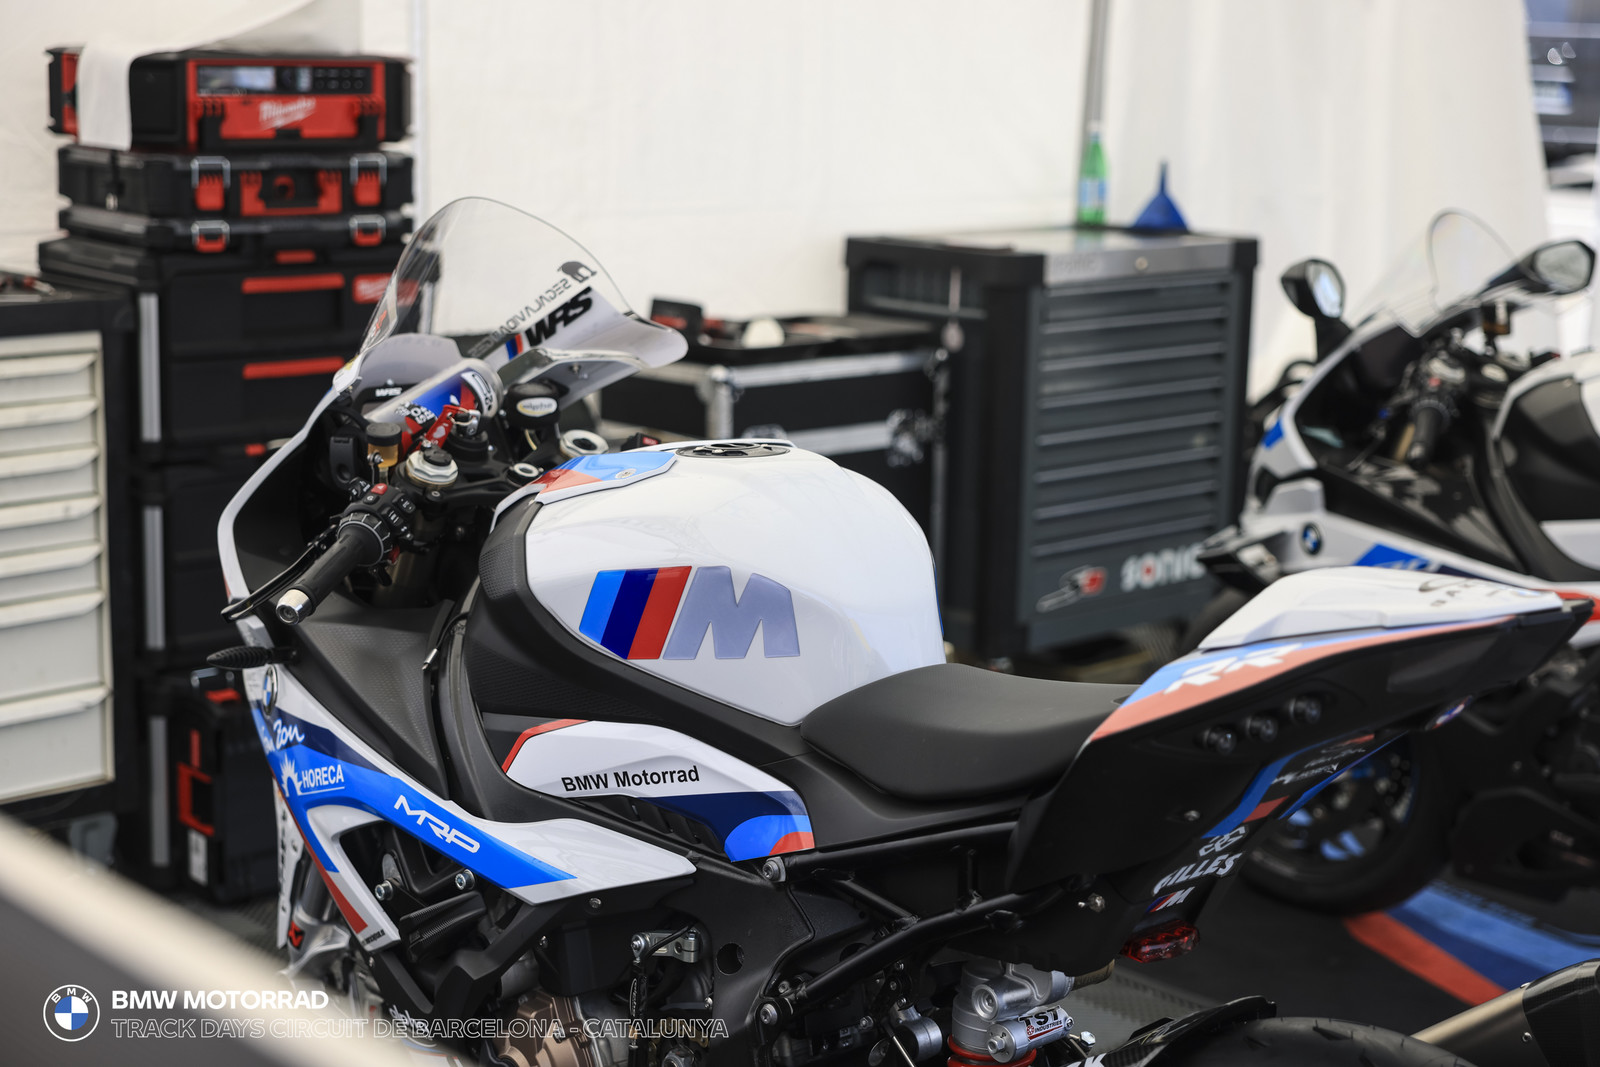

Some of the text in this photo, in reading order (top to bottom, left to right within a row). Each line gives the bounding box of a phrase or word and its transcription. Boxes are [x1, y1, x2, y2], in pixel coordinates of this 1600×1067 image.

[525, 286, 592, 347] WRS
[301, 764, 345, 789] HORECA
[561, 765, 700, 791] BMW Motorrad
[393, 794, 481, 854] MRP
[1153, 852, 1243, 895] GILLES
[1018, 1005, 1061, 1026] TST
[1034, 1020, 1063, 1033] INDUSTRIES
